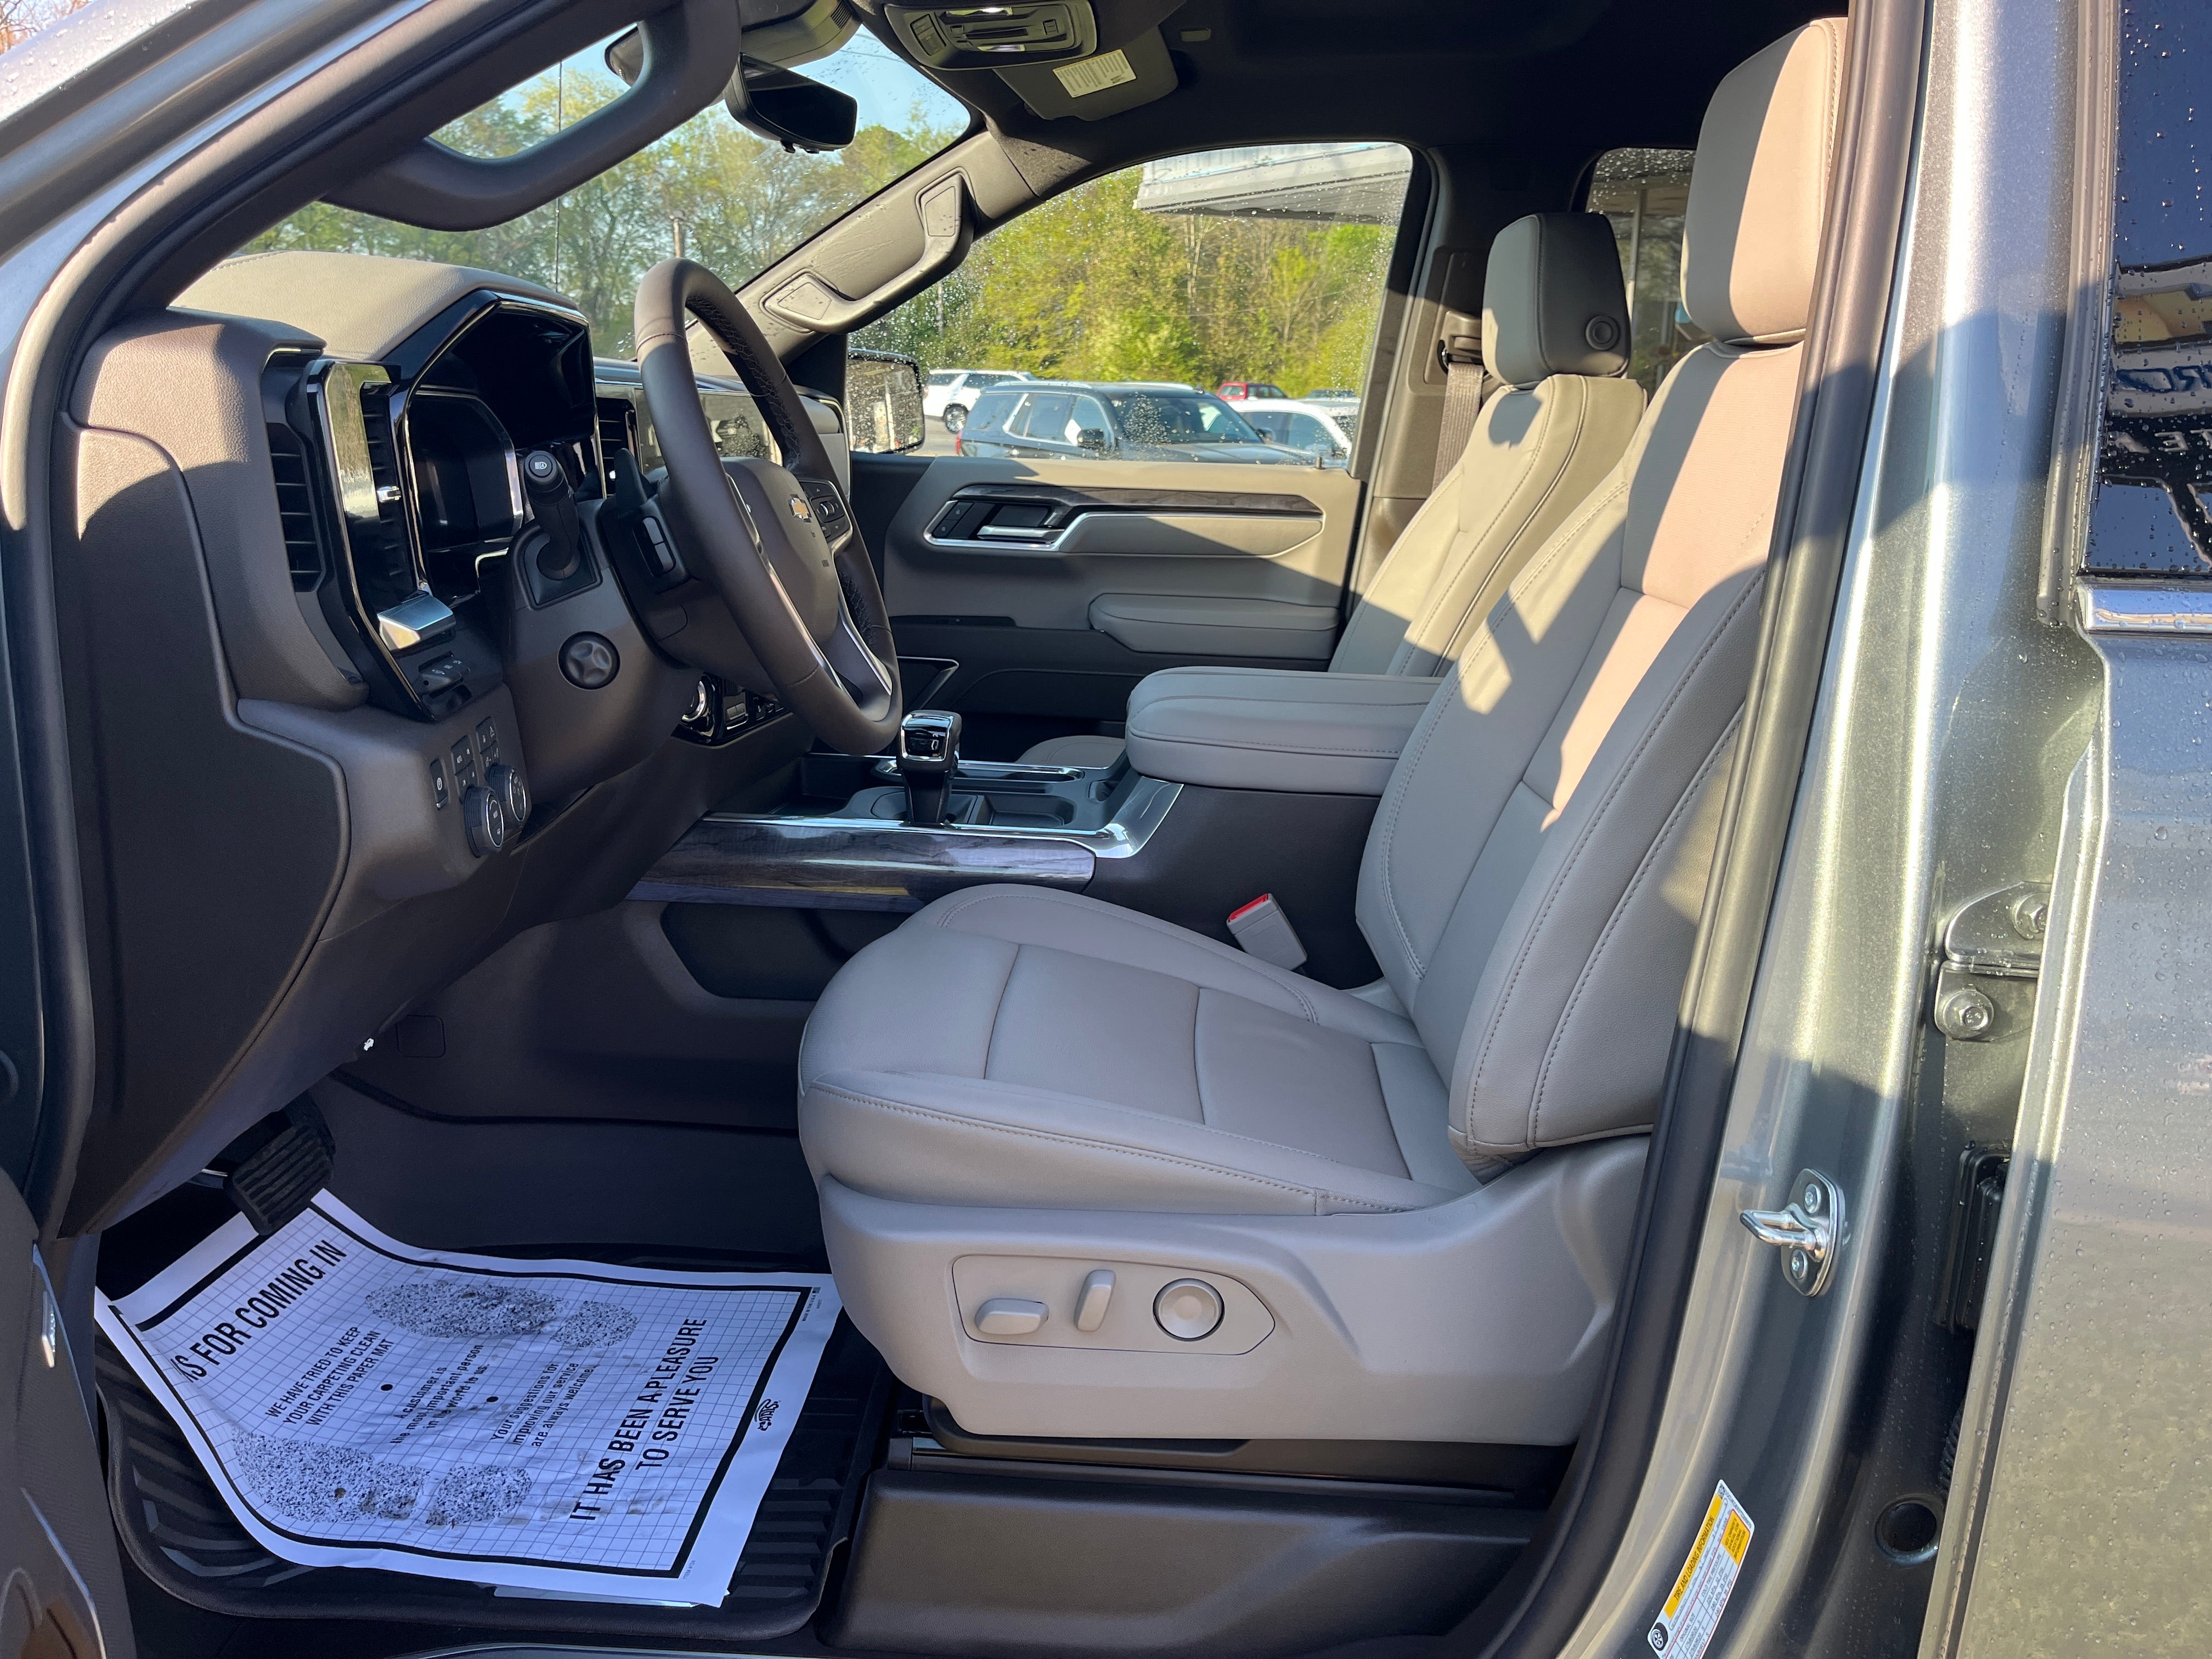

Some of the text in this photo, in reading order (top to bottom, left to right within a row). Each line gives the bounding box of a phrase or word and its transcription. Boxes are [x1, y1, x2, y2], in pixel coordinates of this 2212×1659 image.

[190, 1323, 252, 1365] FOR
[235, 1259, 325, 1328] COMING
[309, 1240, 347, 1267] IN
[265, 1327, 360, 1417] WE HAVE TRIED TO KEEP
[283, 1331, 381, 1424] YOUR CARPETING CLEAN
[306, 1339, 394, 1425] WITH THIS PAPER MAT
[390, 1345, 484, 1443] the most important person
[403, 1376, 439, 1413] customer
[447, 1386, 471, 1408] world
[490, 1363, 559, 1440] Your suggestions for
[532, 1366, 597, 1447] are always welcome.
[543, 1391, 558, 1403] our
[553, 1363, 579, 1389] service
[635, 1357, 719, 1470] TO SERVE YOU
[569, 1318, 707, 1520] IT HAS BEEN A PLEASURE
[1673, 1585, 1683, 1601] TIRE
[1679, 1573, 1688, 1589] AND
[1685, 1550, 1699, 1577] LOADING
[1696, 1514, 1714, 1554] INFORMATION
